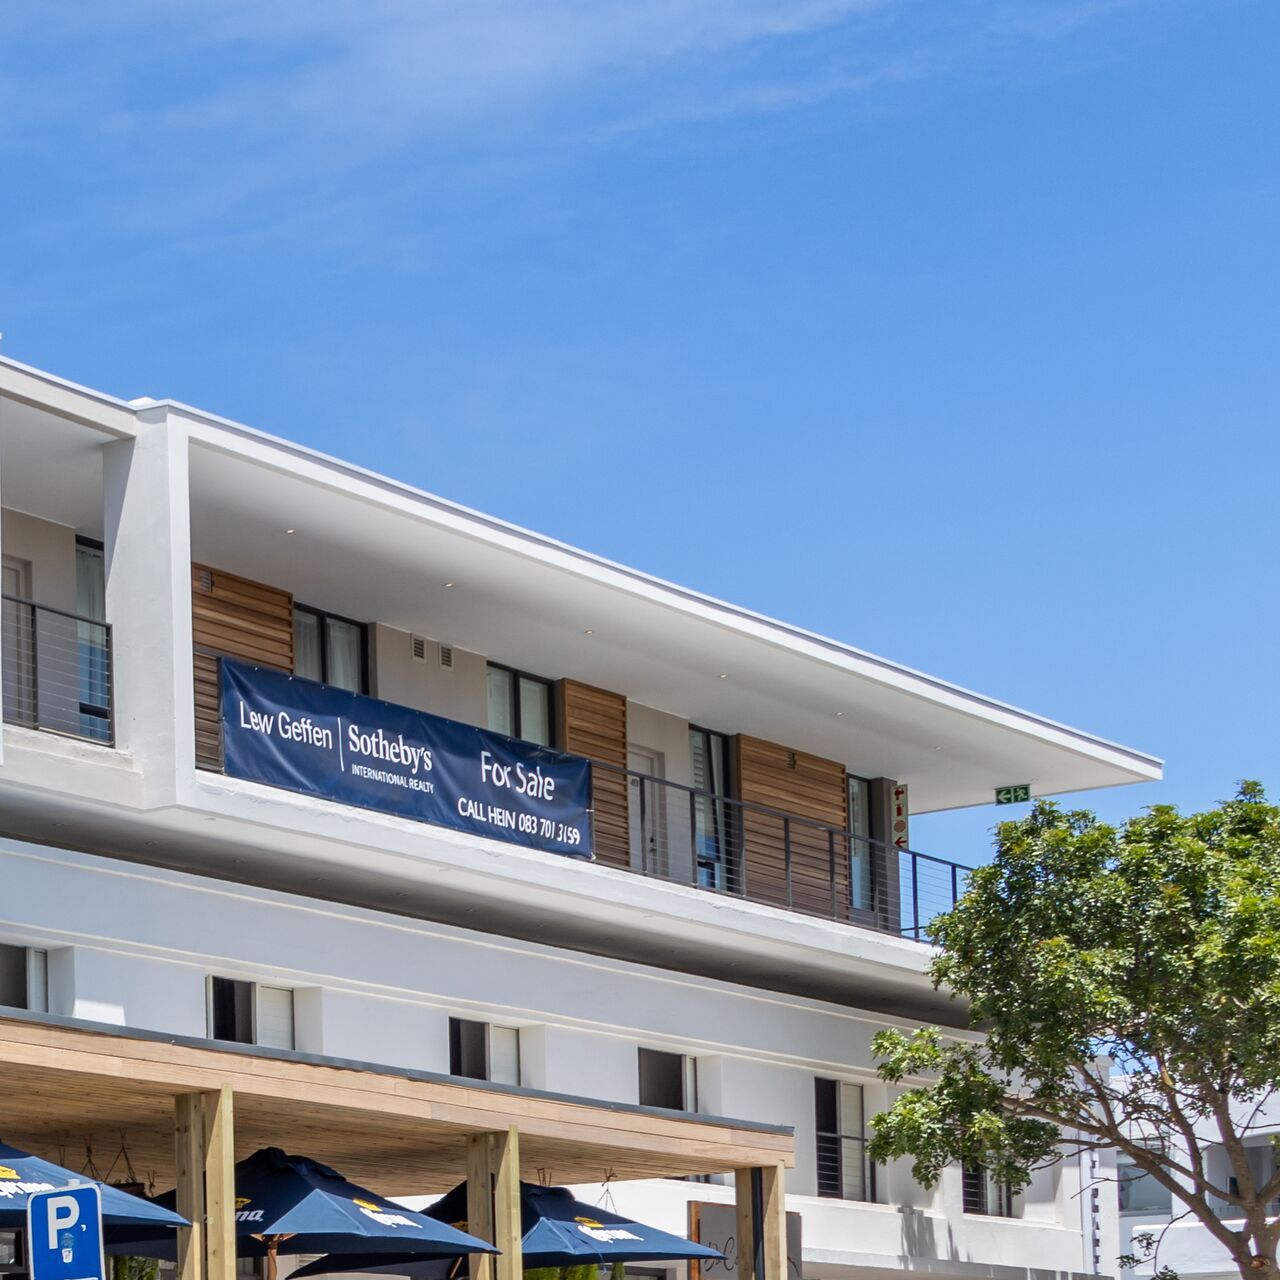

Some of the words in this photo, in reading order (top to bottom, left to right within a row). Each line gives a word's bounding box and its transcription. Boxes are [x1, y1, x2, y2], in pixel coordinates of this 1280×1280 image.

[239, 701, 274, 735] Lew
[278, 711, 333, 750] Geffen
[348, 724, 432, 775] Sotheby's
[351, 764, 409, 788] INTERNATIONAL
[408, 777, 434, 794] REALTY
[481, 750, 512, 789] For
[515, 762, 555, 801] Sale
[458, 797, 487, 822] CALL
[488, 805, 516, 830] HEIN
[518, 813, 538, 834] 083
[540, 818, 555, 839] 701
[557, 823, 581, 845] 3159
[47, 1195, 80, 1250] P
